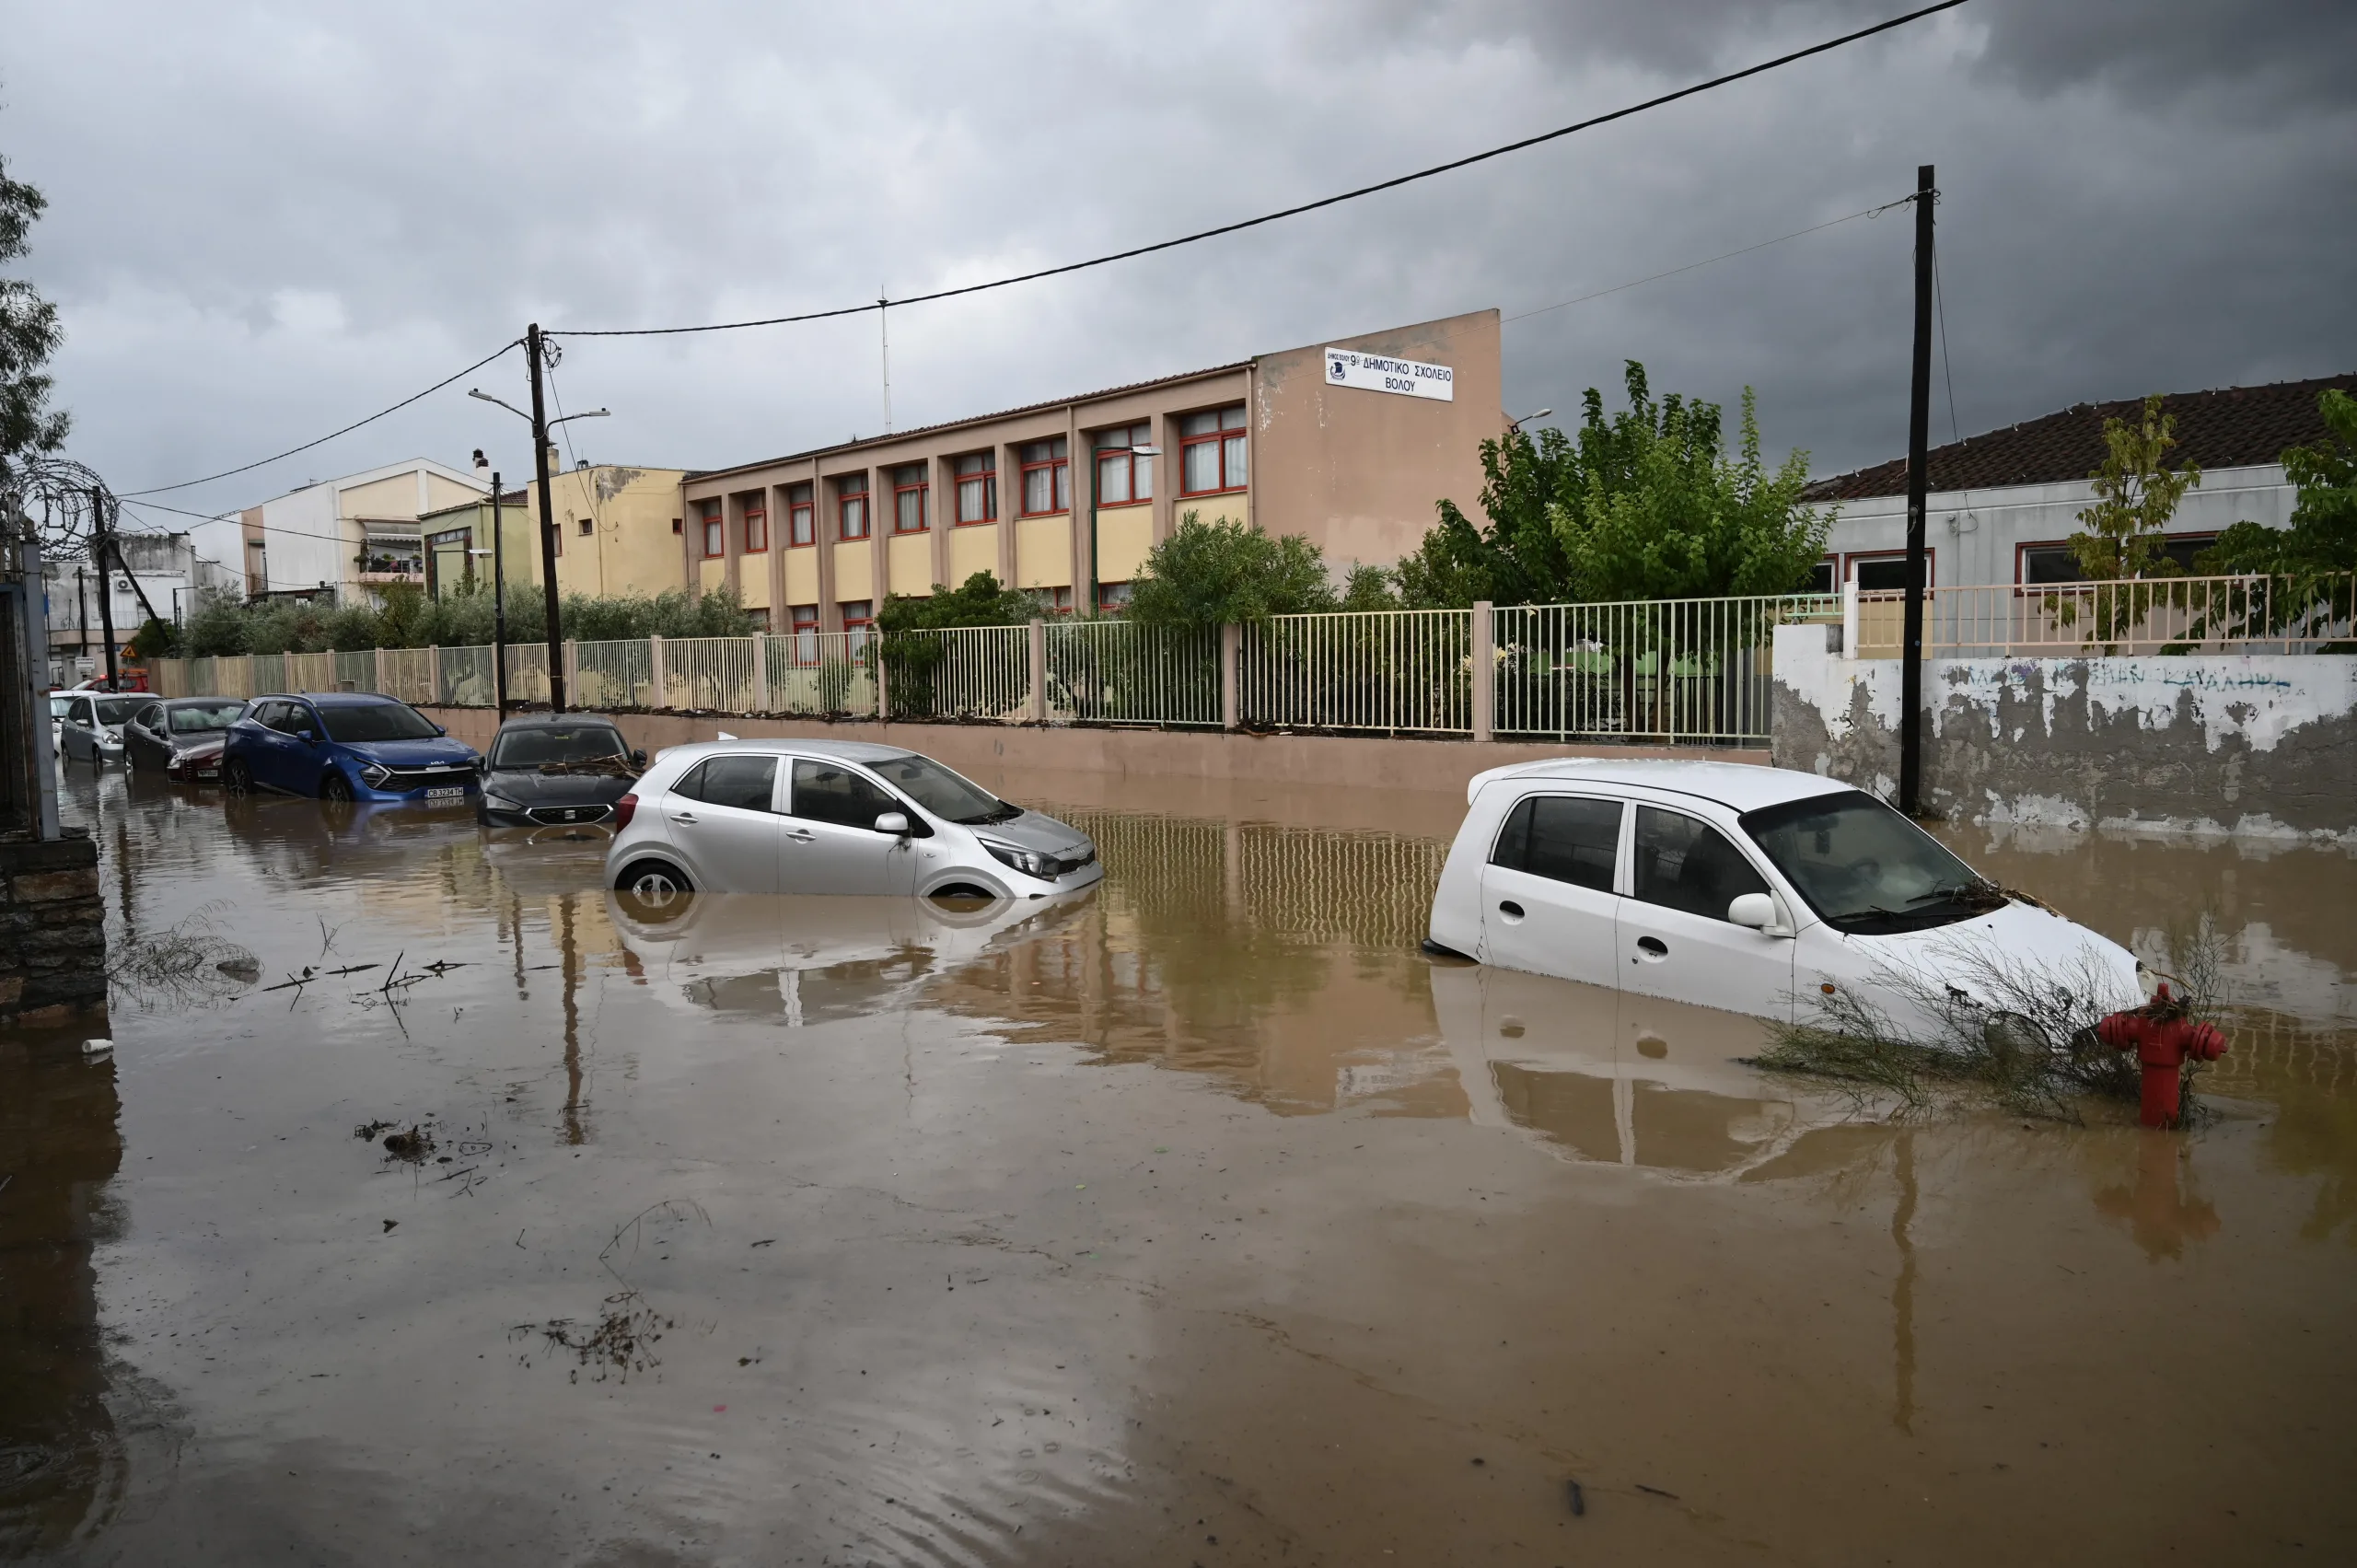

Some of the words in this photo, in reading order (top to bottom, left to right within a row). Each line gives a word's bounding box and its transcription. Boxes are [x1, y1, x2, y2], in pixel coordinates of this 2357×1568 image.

[1328, 353, 1340, 361] ΔΗΜΟΣ
[1339, 354, 1350, 362] ΒΟΛΟΥ
[1363, 356, 1410, 376] ΔΗΜΟΤΙΚΟ
[1414, 365, 1452, 382] ΣΧΟΛΕΙΟ
[1385, 377, 1416, 392] ΒΟΛΟΥ
[429, 789, 438, 797] CB
[438, 788, 454, 796] 3234
